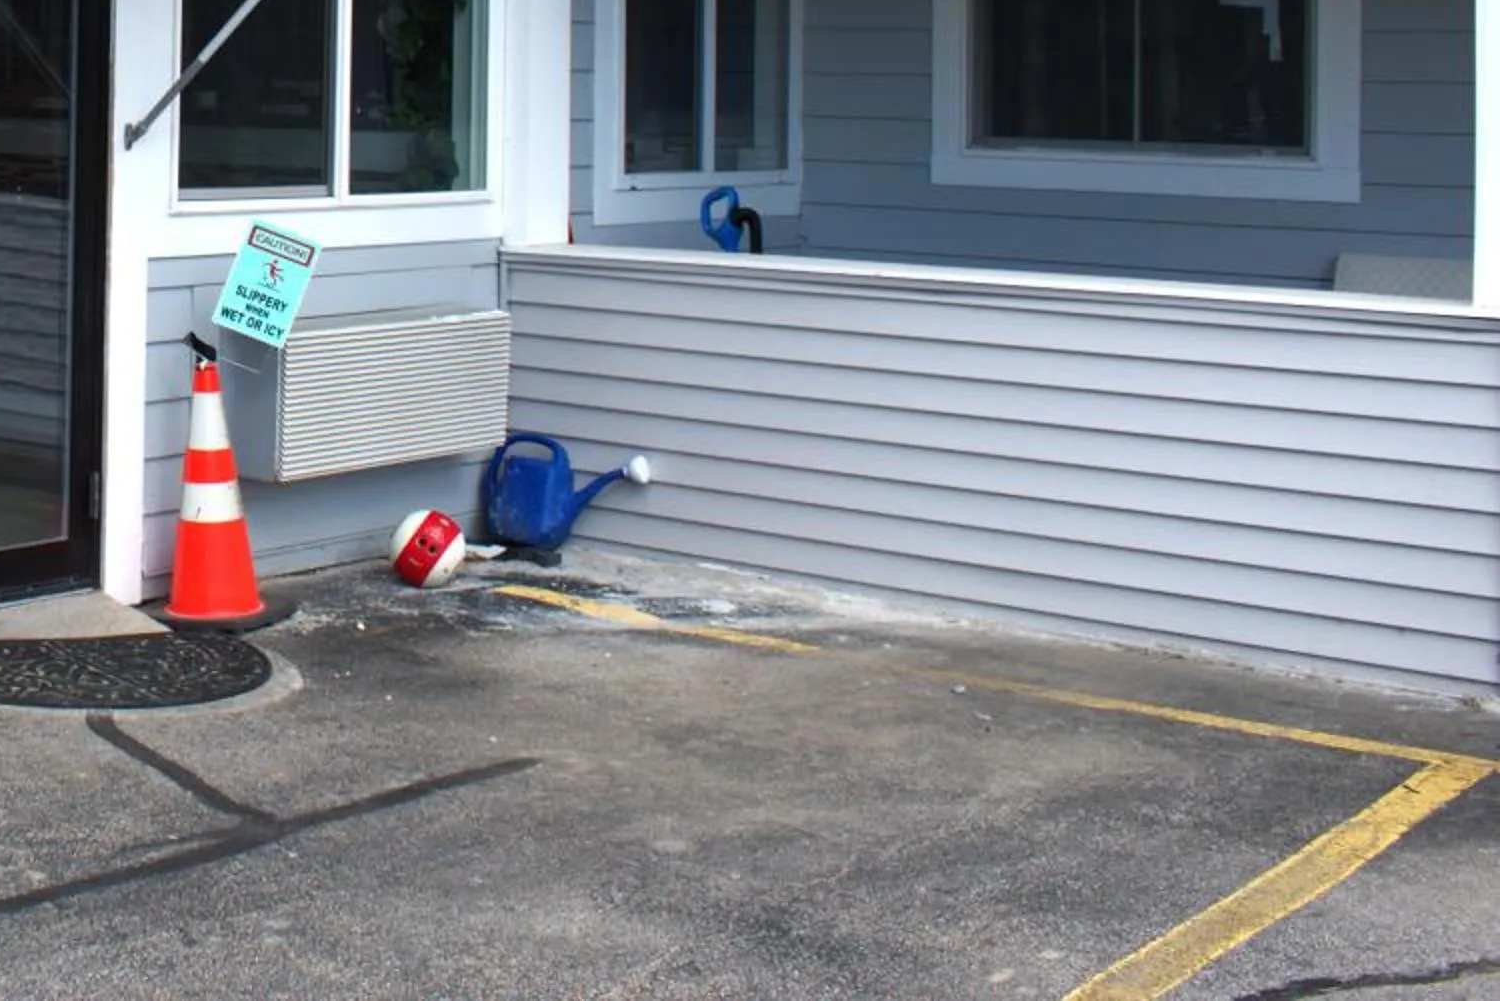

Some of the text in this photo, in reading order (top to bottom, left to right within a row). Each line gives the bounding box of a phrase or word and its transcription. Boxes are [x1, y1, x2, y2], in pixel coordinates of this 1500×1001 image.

[235, 284, 288, 313] SLIPPERY
[245, 303, 271, 319] WHEN
[220, 306, 285, 340] WET OR ICY
